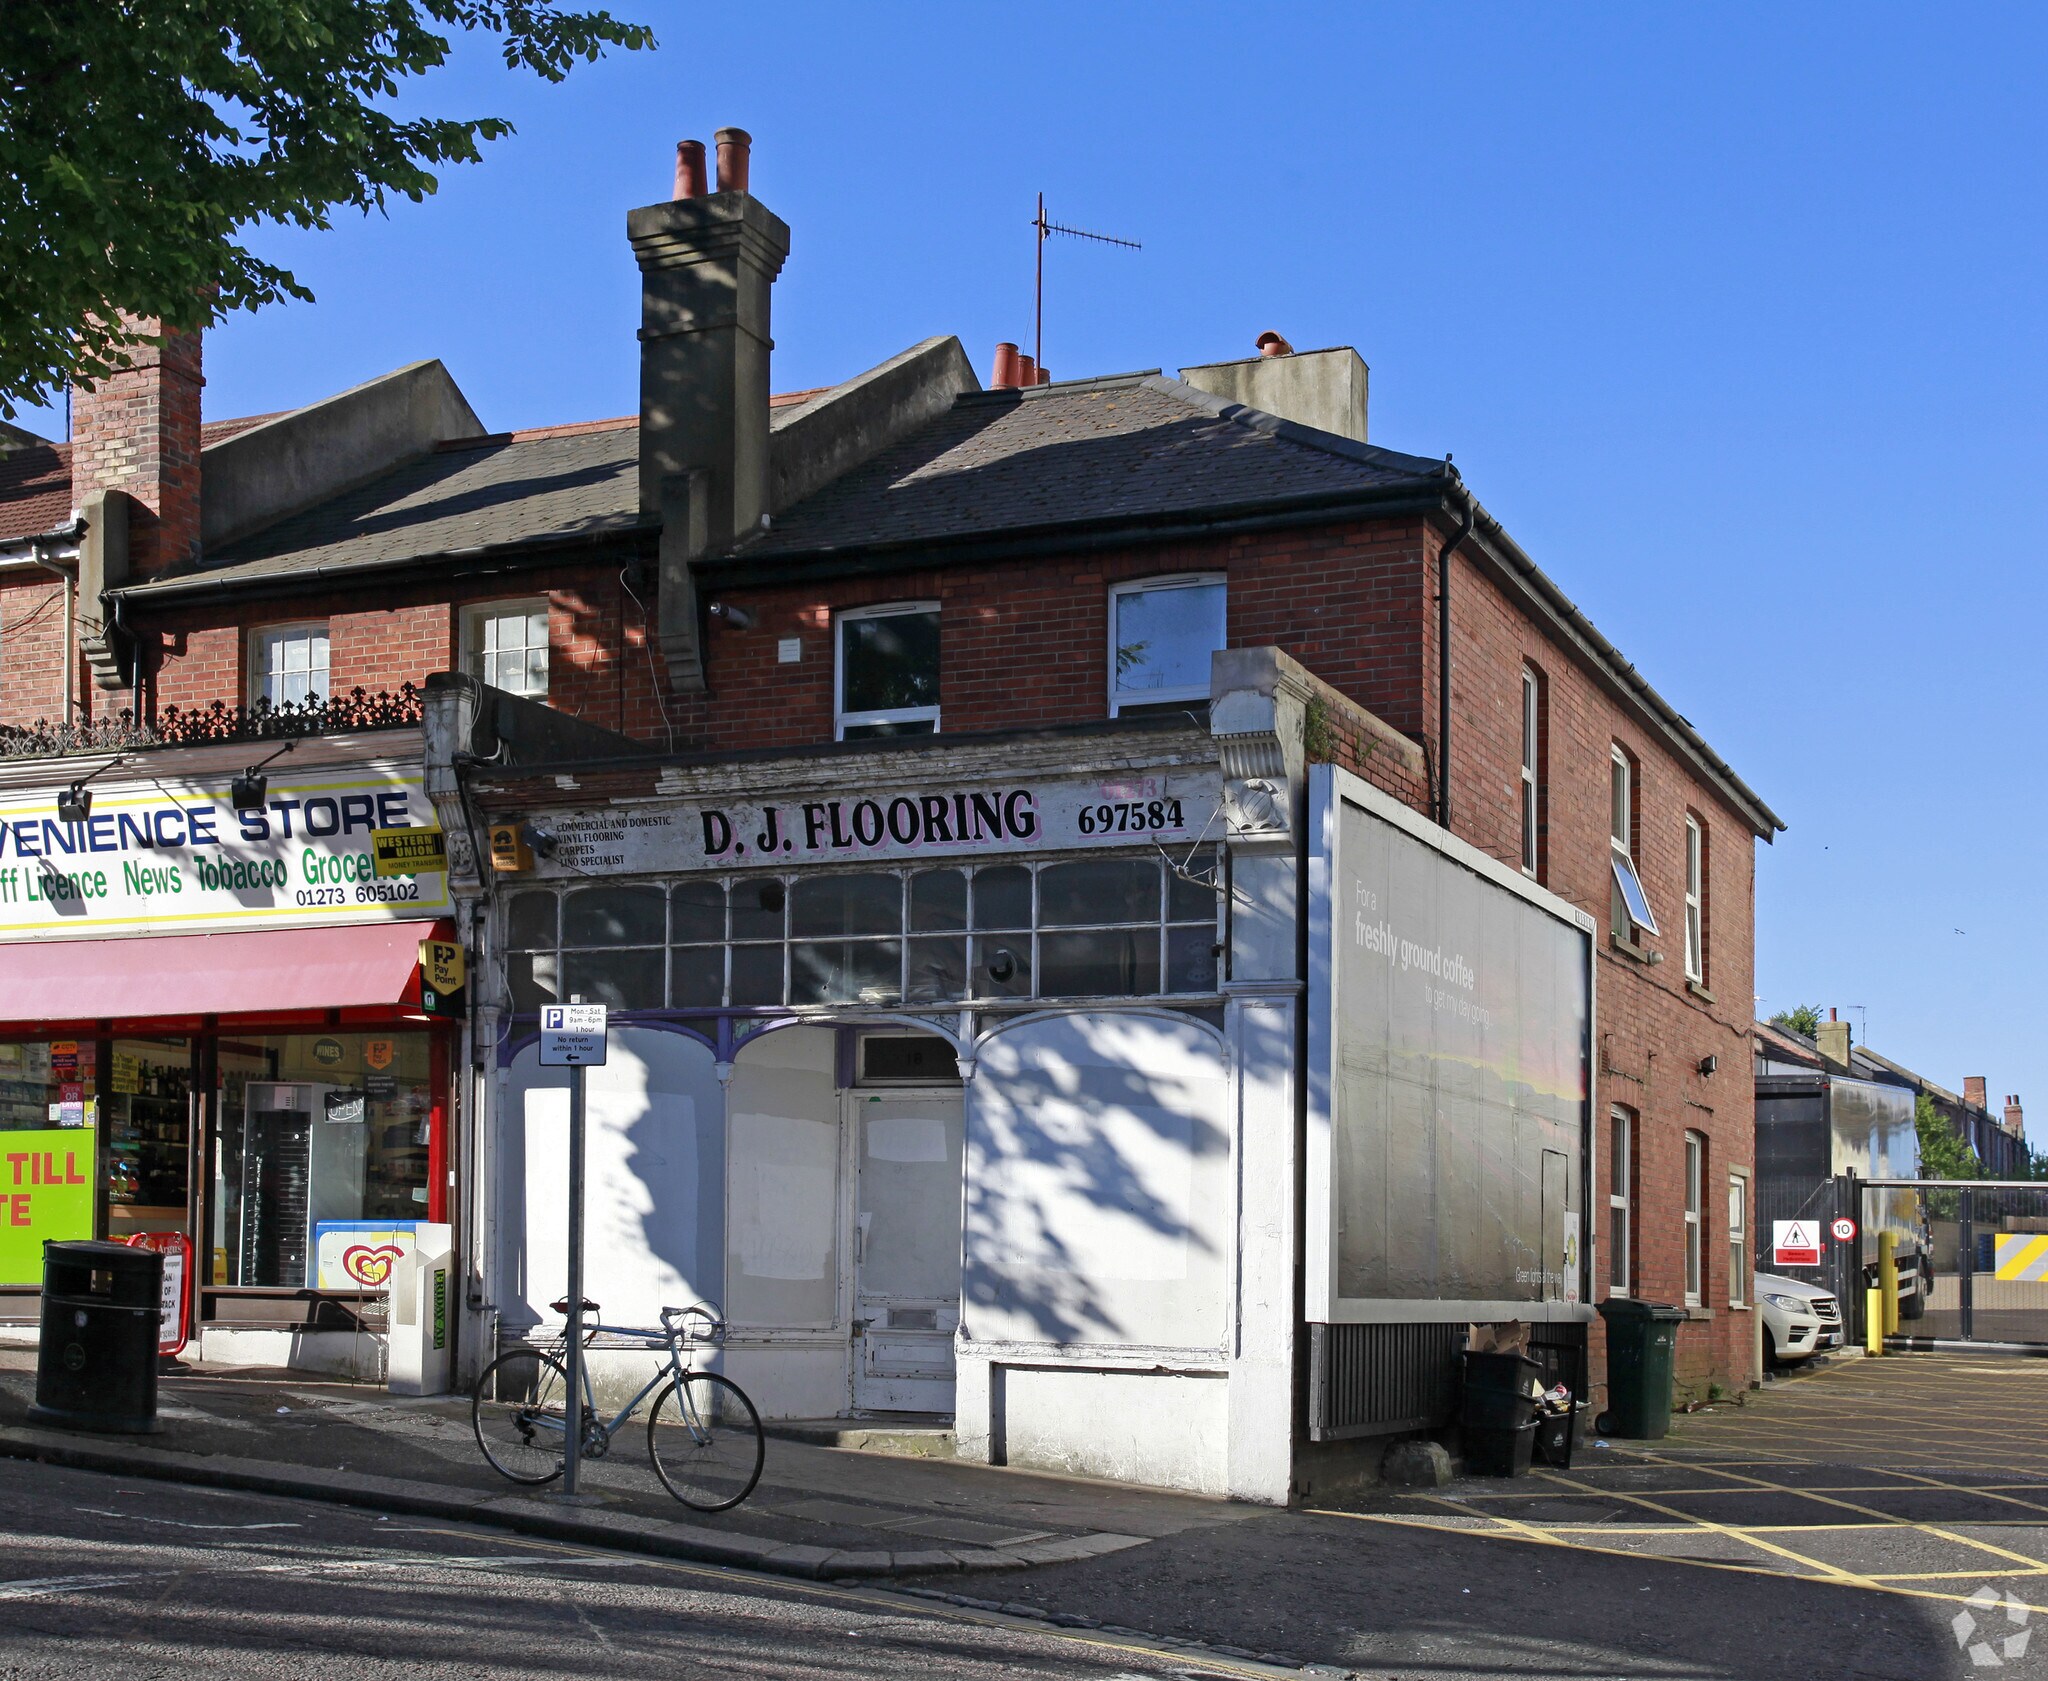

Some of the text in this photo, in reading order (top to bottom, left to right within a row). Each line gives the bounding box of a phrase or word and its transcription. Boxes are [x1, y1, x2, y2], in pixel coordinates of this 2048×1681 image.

[237, 791, 411, 842] STORE
[802, 789, 1037, 849] FLOORING
[1078, 799, 1185, 834] 697584
[556, 815, 672, 833] COMMERCIAL AND DOMESTIC
[376, 834, 433, 848] WESTERN
[557, 831, 625, 844] VINYL FLOORING
[395, 845, 434, 857] UNION
[558, 844, 595, 856] CARPETS
[412, 858, 444, 867] TRANSFER
[560, 854, 625, 868] LINO SPECIALIST
[24, 866, 108, 902] Licence
[122, 859, 183, 896] News
[193, 855, 288, 892] Tobacco
[302, 847, 418, 885] Groce
[296, 883, 419, 906] 01273 605102
[1356, 879, 1377, 911] For a
[1355, 910, 1475, 991] freshly ground coffee
[434, 963, 449, 977] Pay
[434, 973, 457, 985] Point
[589, 1007, 601, 1015] Sat
[1425, 985, 1433, 1004] to
[1433, 988, 1446, 1011] get
[1446, 992, 1458, 1018] my
[1458, 993, 1471, 1023] day
[316, 1045, 340, 1058] WINES
[65, 1092, 78, 1100] OR
[6, 1152, 86, 1186] TILL
[1836, 1224, 1850, 1235] 10
[157, 1244, 182, 1255] Argus
[1515, 1266, 1530, 1283] Green
